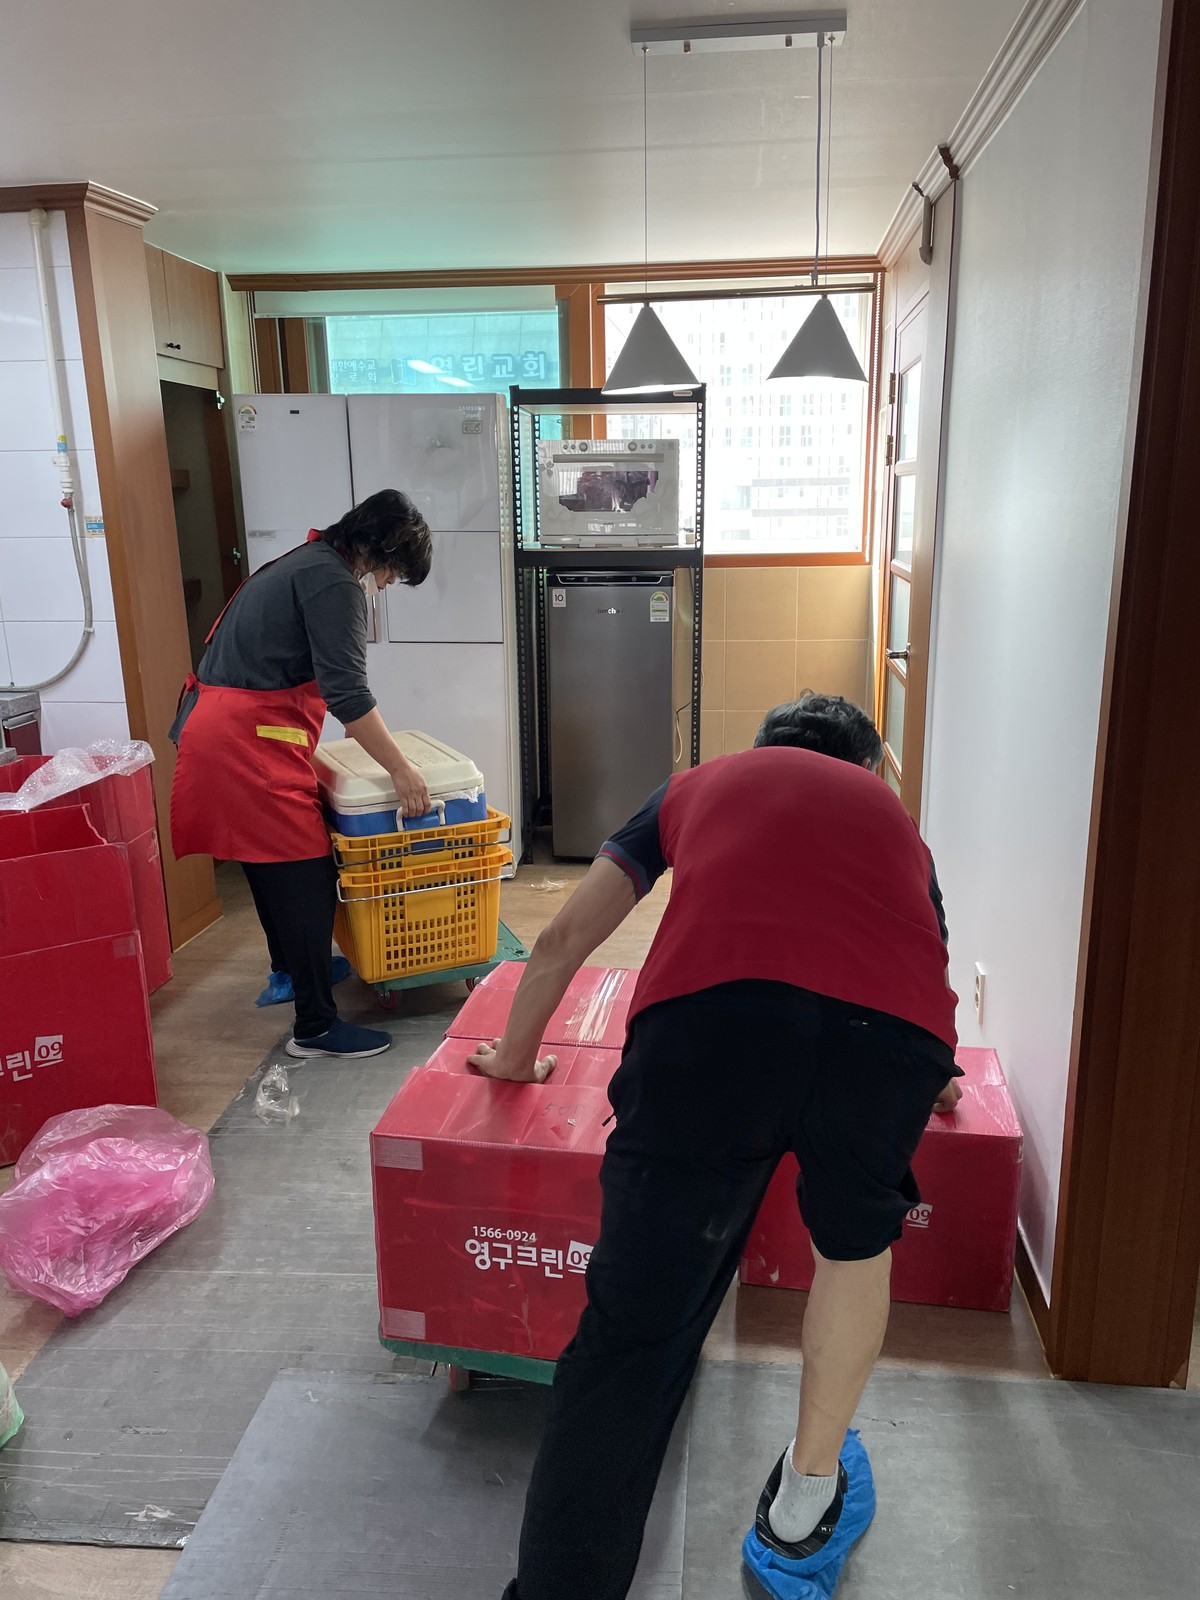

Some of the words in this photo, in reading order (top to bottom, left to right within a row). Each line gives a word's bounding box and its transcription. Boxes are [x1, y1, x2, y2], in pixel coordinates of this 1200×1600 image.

[0, 1050, 33, 1082] 린
[908, 1208, 930, 1222] 09
[473, 1226, 536, 1242] 1566-0924
